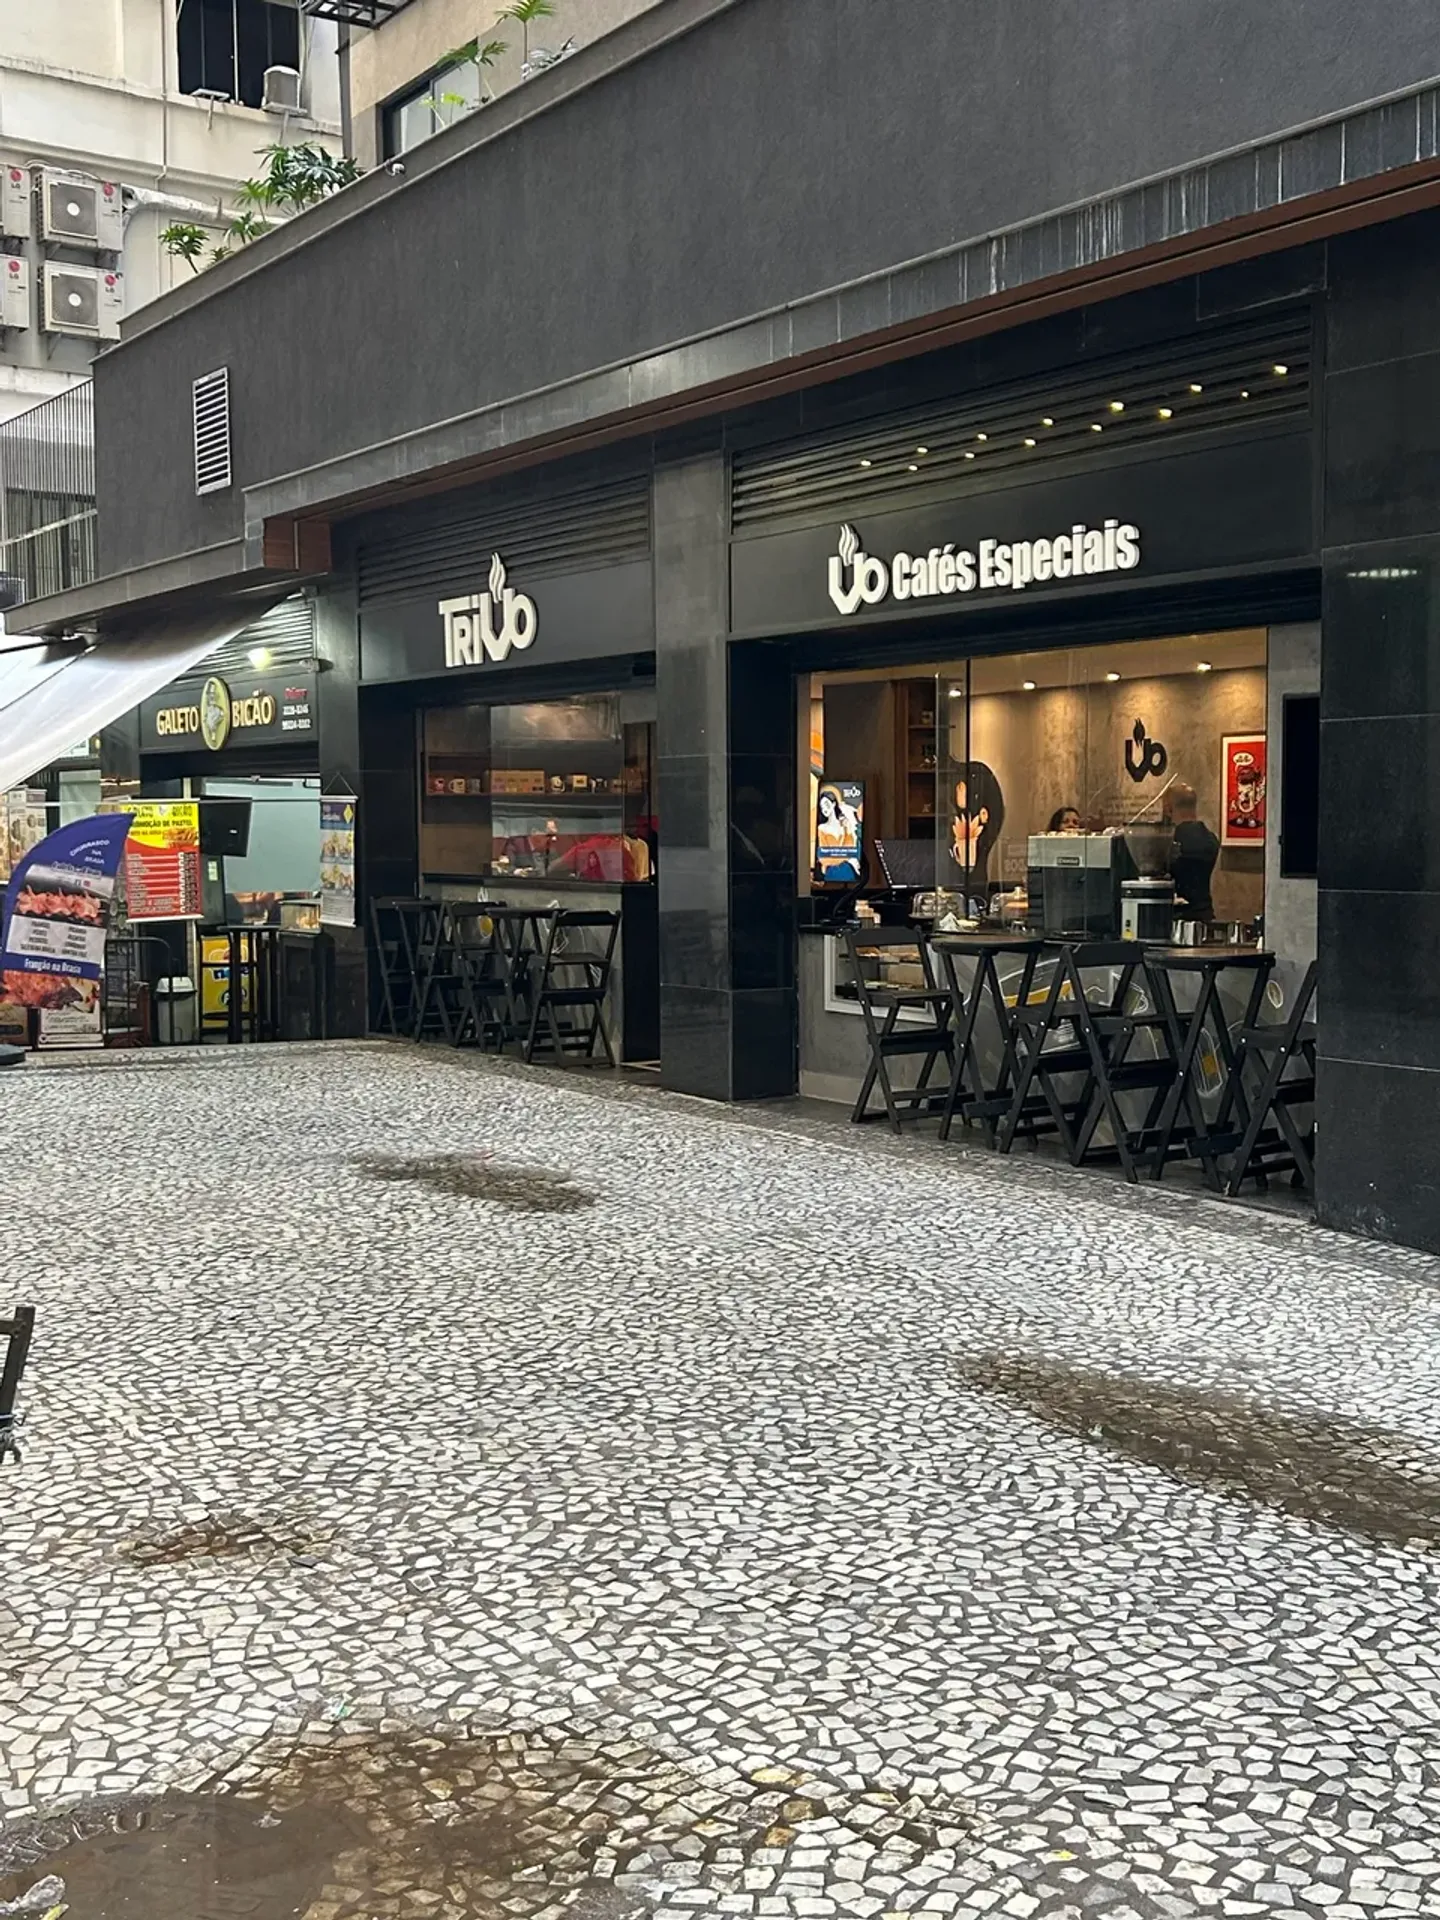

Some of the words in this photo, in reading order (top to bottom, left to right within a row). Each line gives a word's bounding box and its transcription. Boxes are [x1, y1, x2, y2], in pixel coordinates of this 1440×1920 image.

[892, 543, 977, 600] Cafés
[979, 519, 1141, 589] Especiais
[156, 706, 199, 736] GALETO
[232, 689, 276, 728] BICÃO
[69, 839, 110, 857] CHURRASCO
